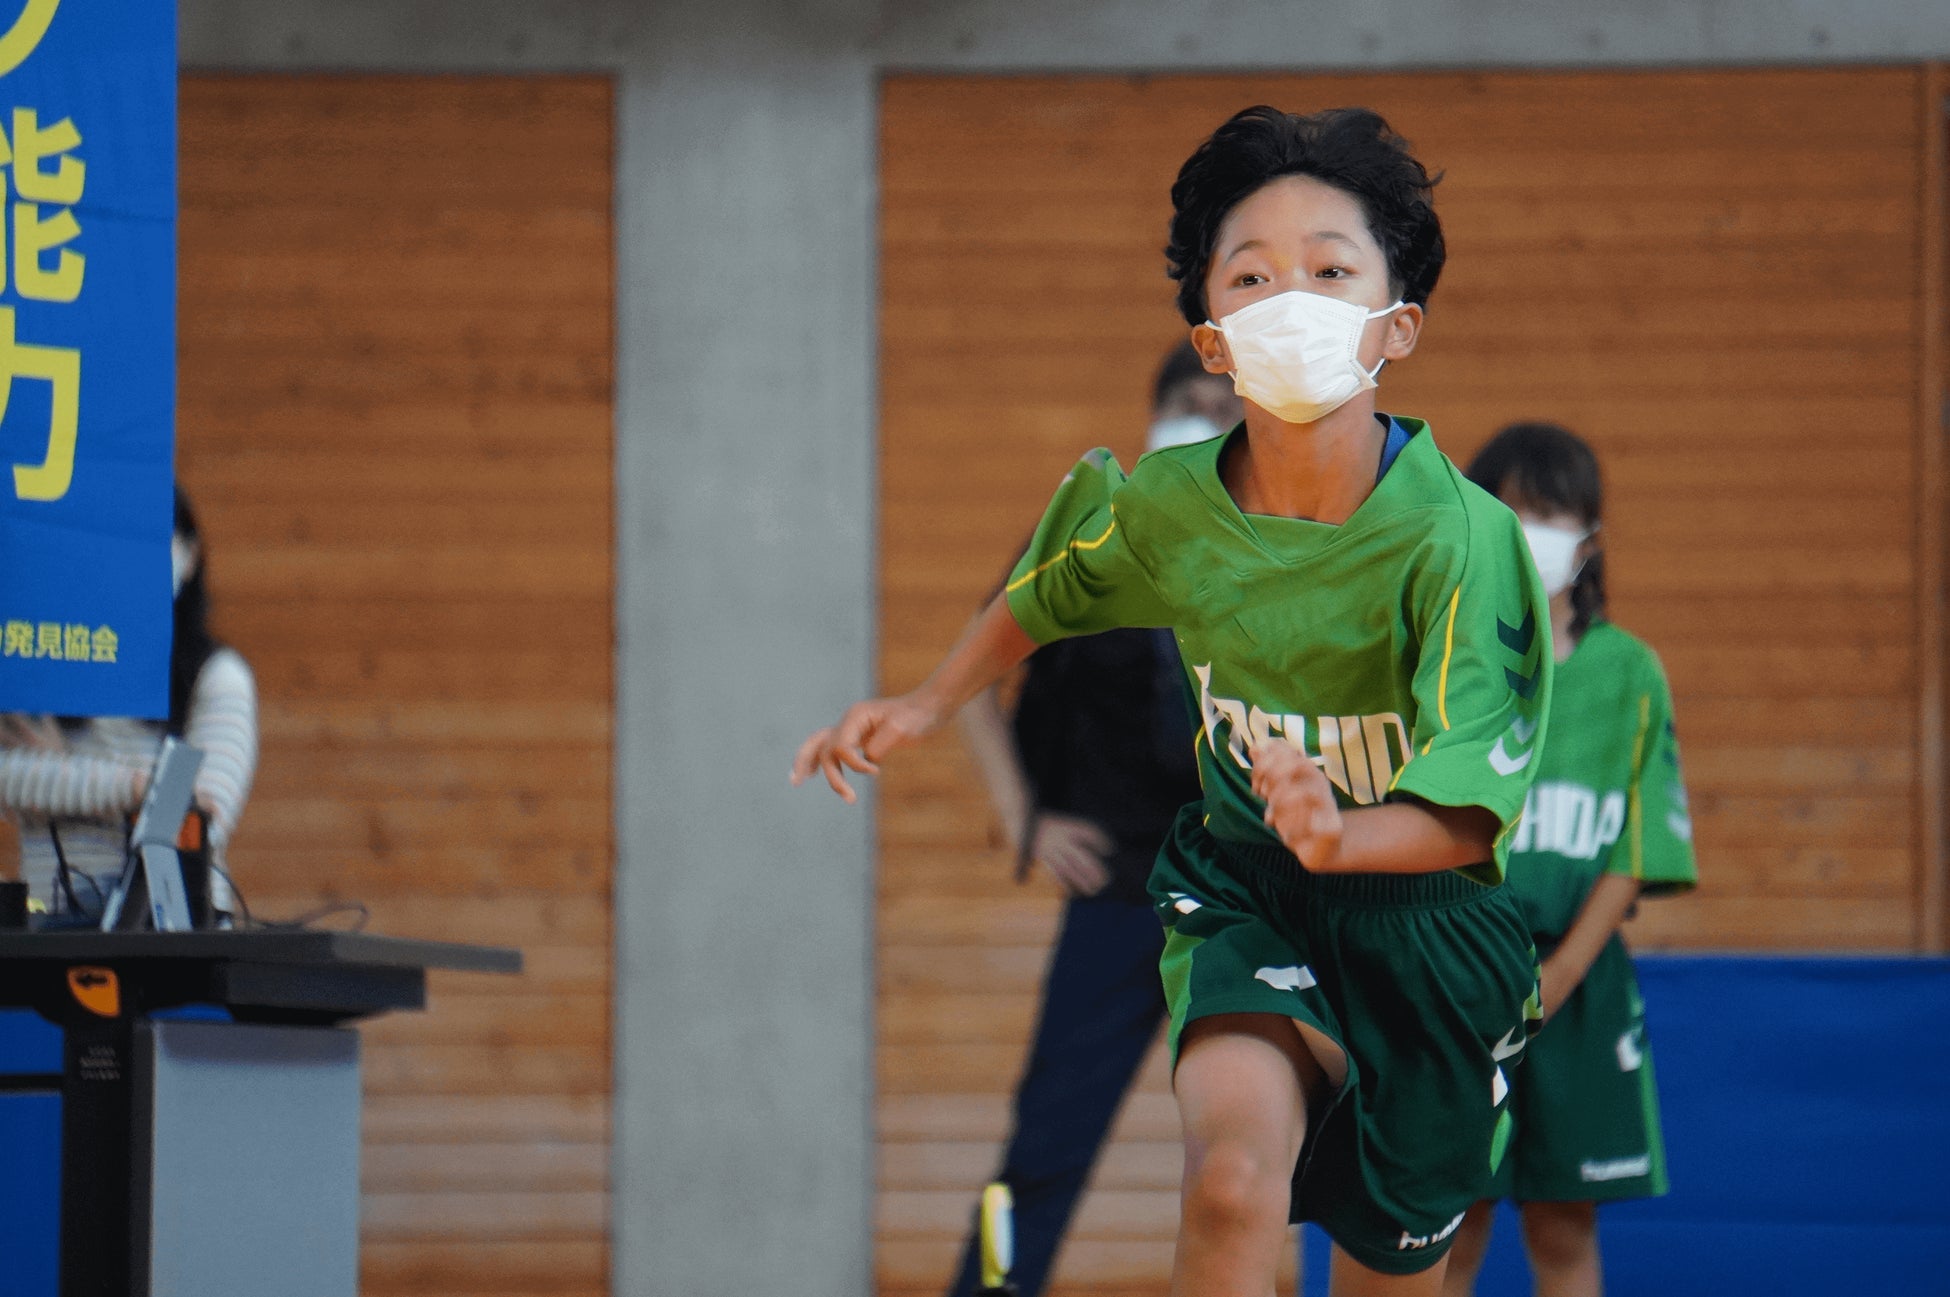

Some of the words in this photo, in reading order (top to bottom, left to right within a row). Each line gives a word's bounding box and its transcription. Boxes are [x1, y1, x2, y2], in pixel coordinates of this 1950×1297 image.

[0, 0, 86, 502] 能力
[0, 620, 118, 662] 発見協会
[1512, 783, 1626, 860] HIDA
